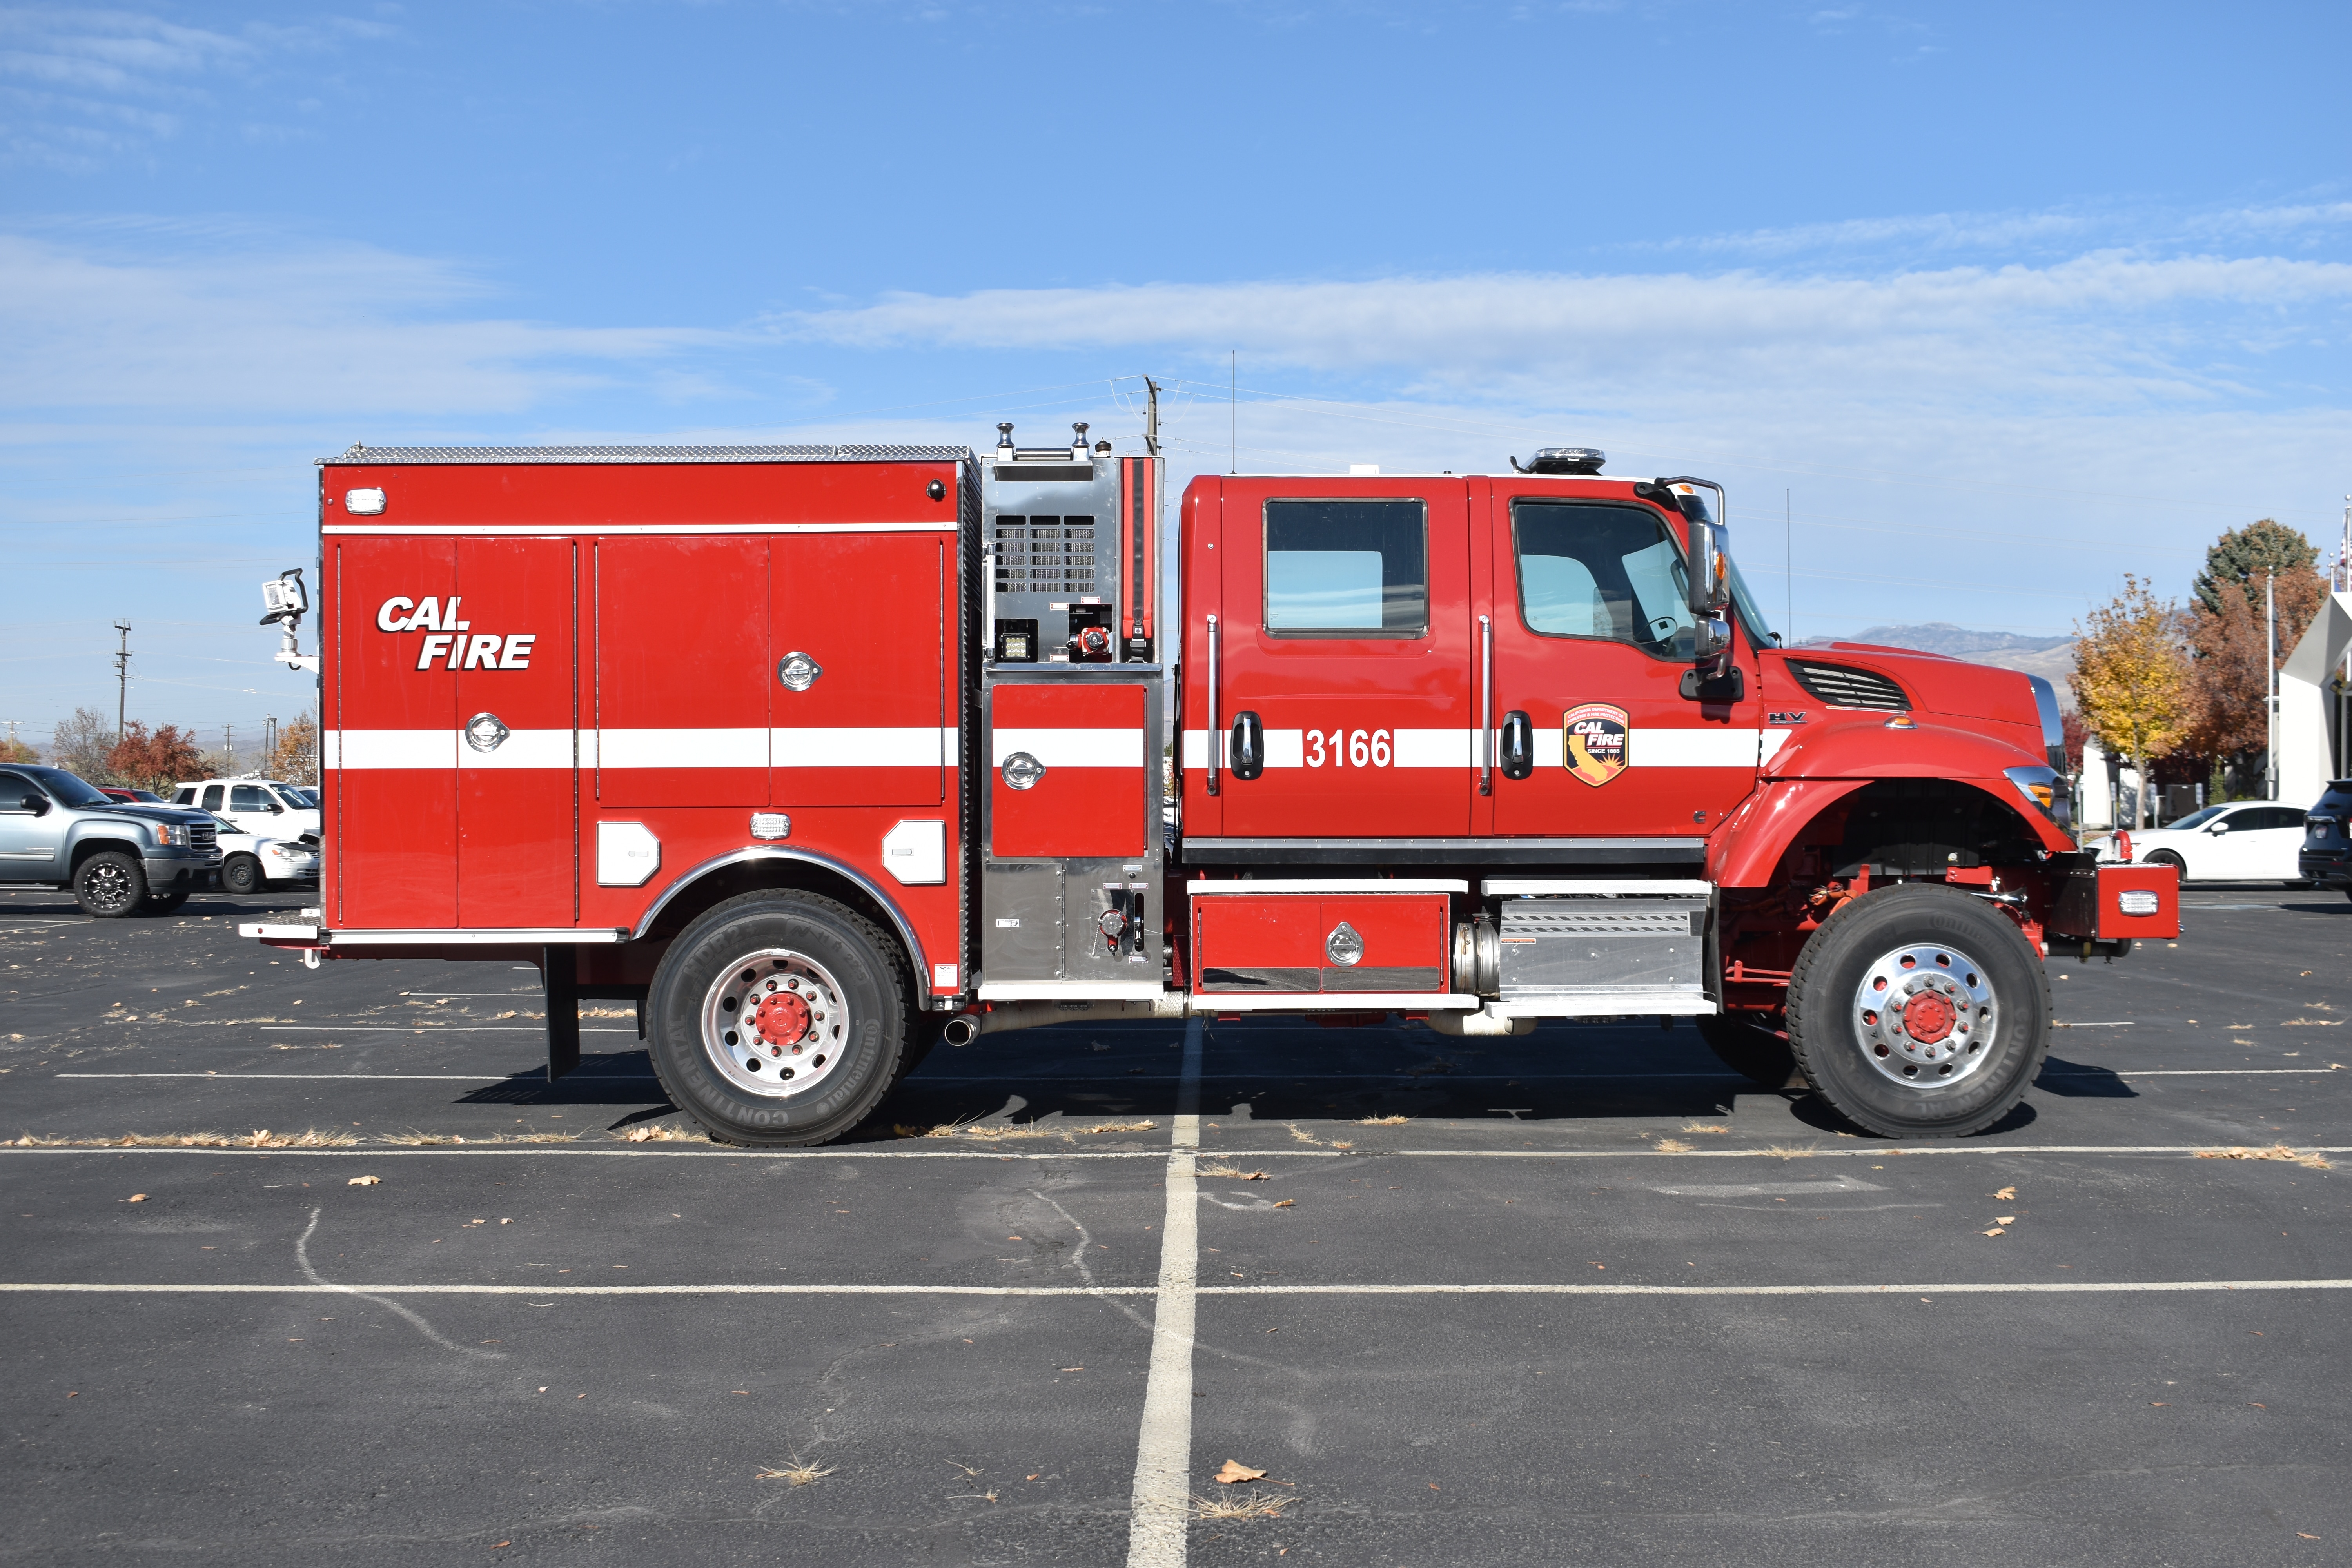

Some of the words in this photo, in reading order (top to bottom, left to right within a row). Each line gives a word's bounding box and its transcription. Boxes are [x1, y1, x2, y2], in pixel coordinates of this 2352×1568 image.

[377, 596, 470, 632] CAL
[417, 634, 536, 669] FIRE
[1567, 713, 1587, 724] FORESTRY
[1600, 713, 1624, 724] PROTECTION
[1568, 708, 1591, 719] CALIFORNIA
[1592, 707, 1618, 716] DEPARTMENT
[1768, 712, 1806, 721] HV
[1575, 722, 1605, 734] CAL
[1306, 729, 1391, 768] 3166
[1587, 734, 1625, 746] FIRE
[668, 1015, 789, 1128] CONTINENTAL
[828, 1019, 881, 1109] Continental
